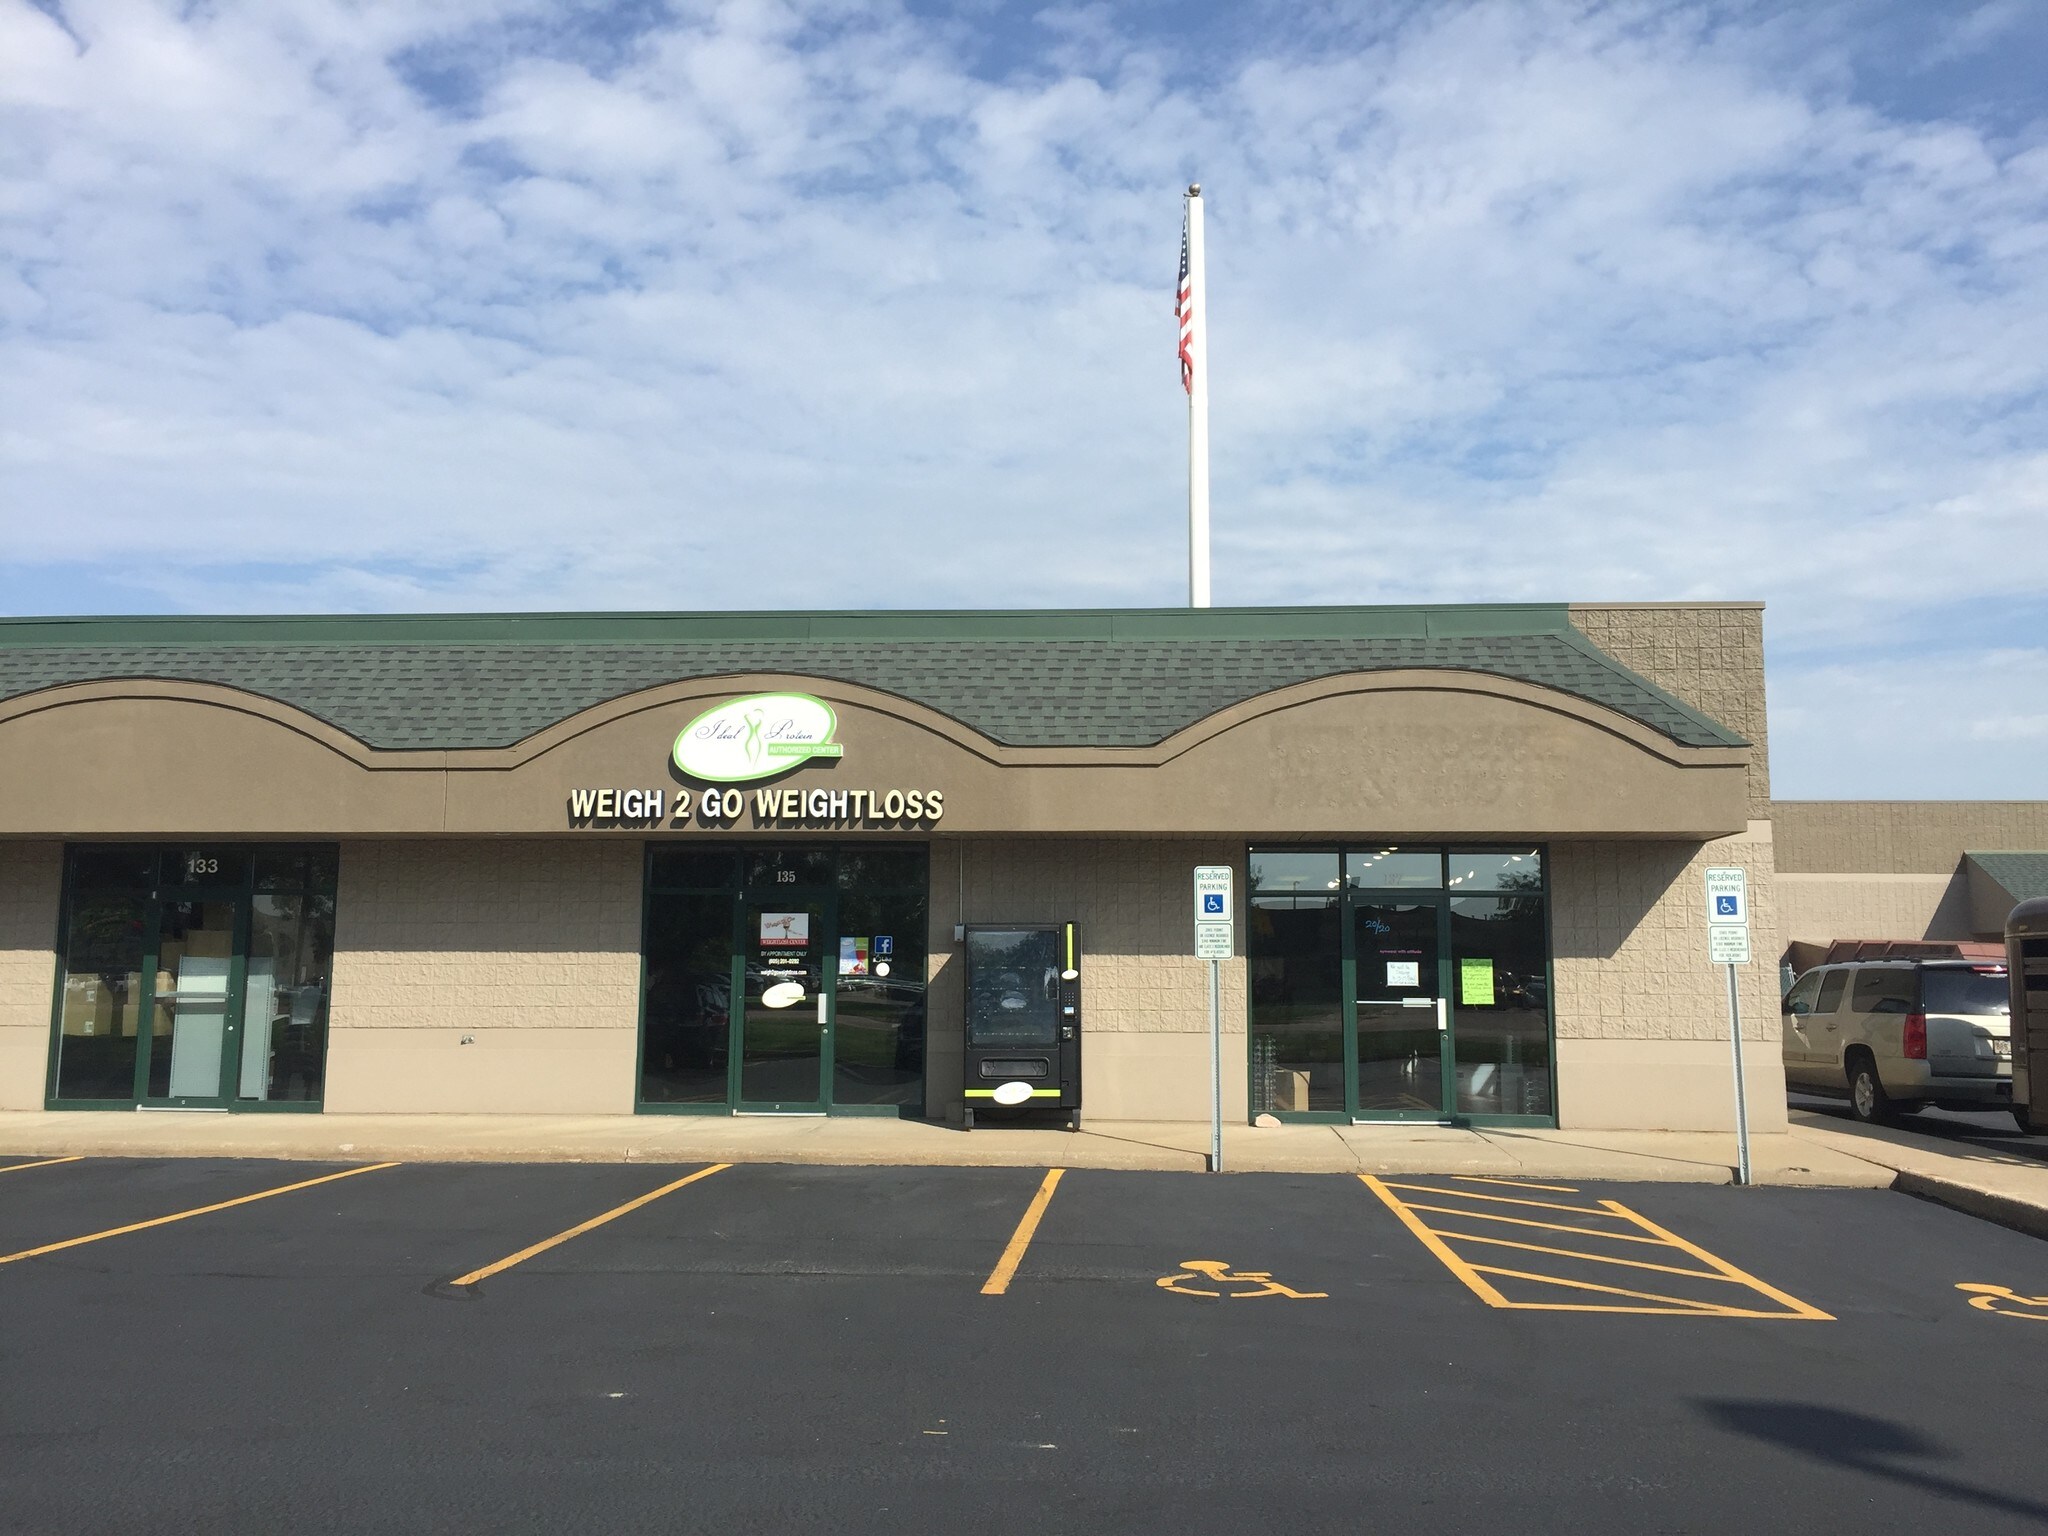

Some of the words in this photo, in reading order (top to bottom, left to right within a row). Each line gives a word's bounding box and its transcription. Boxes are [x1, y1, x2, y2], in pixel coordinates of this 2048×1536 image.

[695, 719, 745, 740] Ideal
[764, 719, 813, 740] Protein
[770, 746, 812, 754] AUTHORIZED
[812, 745, 839, 754] CENTER
[571, 788, 664, 819] WEIGH
[675, 789, 691, 818] 2
[701, 787, 744, 819] GO
[756, 788, 944, 820] WEIGHTLOSS
[187, 859, 218, 873] 133
[776, 870, 796, 883] 135
[1197, 872, 1230, 881] RESERVED
[1708, 873, 1743, 882] RESERVED
[1199, 883, 1228, 891] PARKING
[1711, 884, 1741, 892] PARKING
[1365, 918, 1391, 935] 20/20
